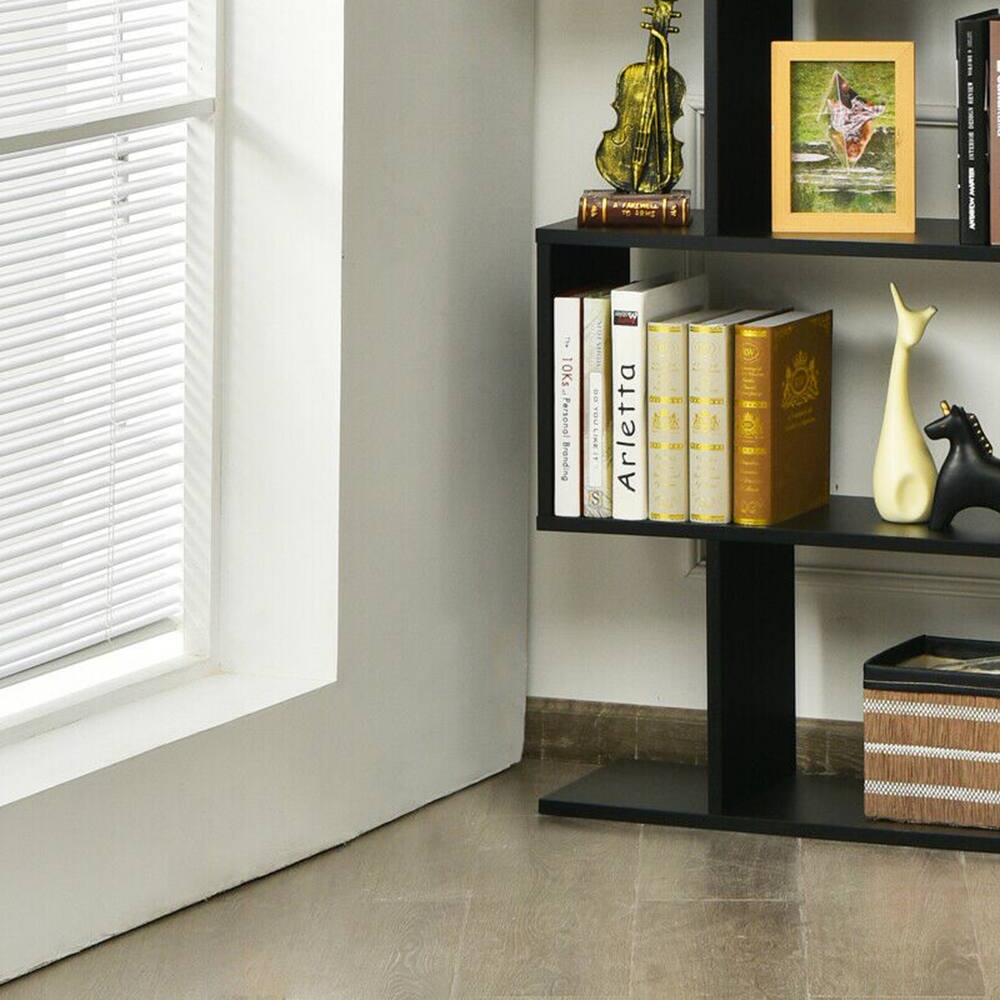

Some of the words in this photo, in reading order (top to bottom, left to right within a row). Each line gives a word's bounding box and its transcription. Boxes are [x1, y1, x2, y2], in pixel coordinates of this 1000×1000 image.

[561, 356, 573, 387] 10Ks
[562, 397, 571, 438] Personal
[616, 363, 637, 493] Arletta
[561, 442, 571, 481] Branding
